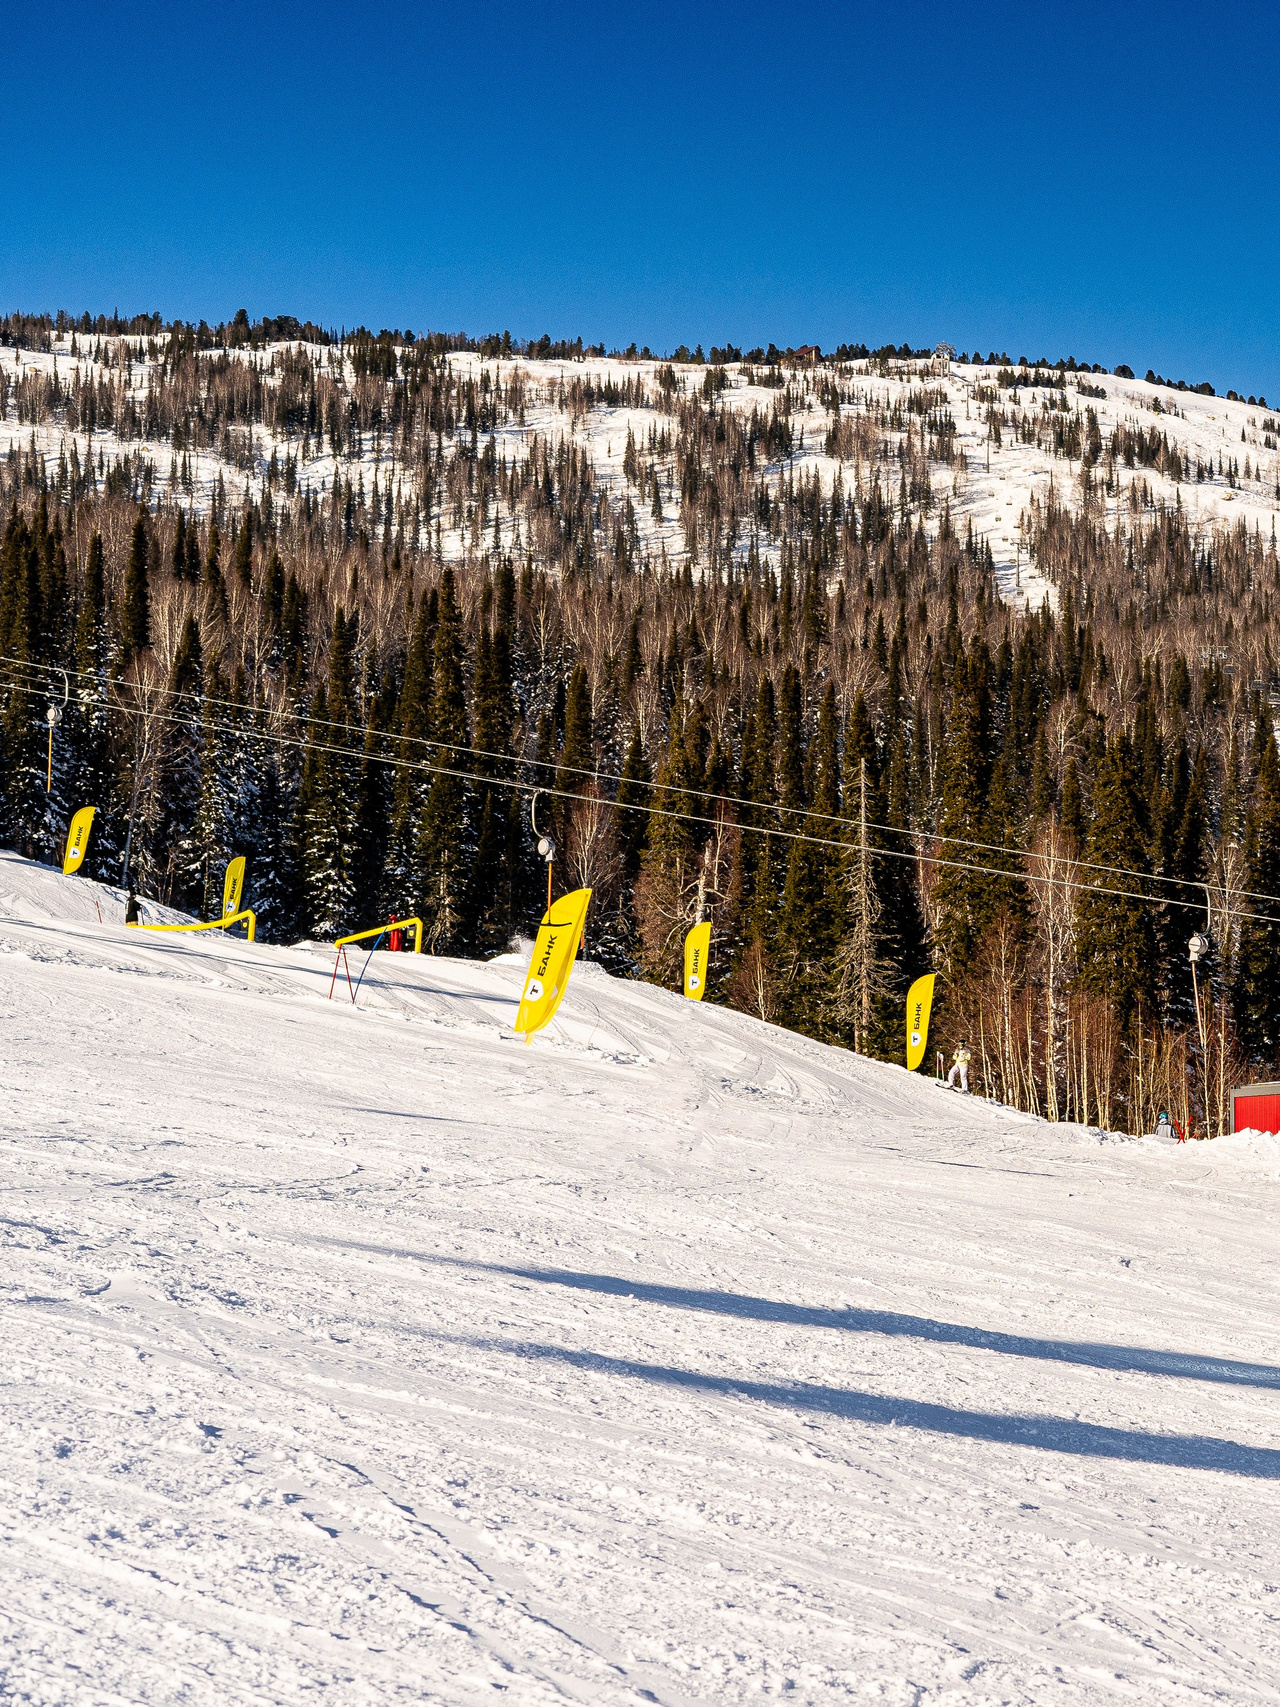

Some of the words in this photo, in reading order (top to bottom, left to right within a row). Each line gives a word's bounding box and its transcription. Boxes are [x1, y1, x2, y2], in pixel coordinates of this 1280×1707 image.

[75, 826, 84, 847] БАНК
[537, 934, 558, 977] БАНК
[692, 948, 700, 974] БАНК
[913, 1002, 923, 1030] БАНК
